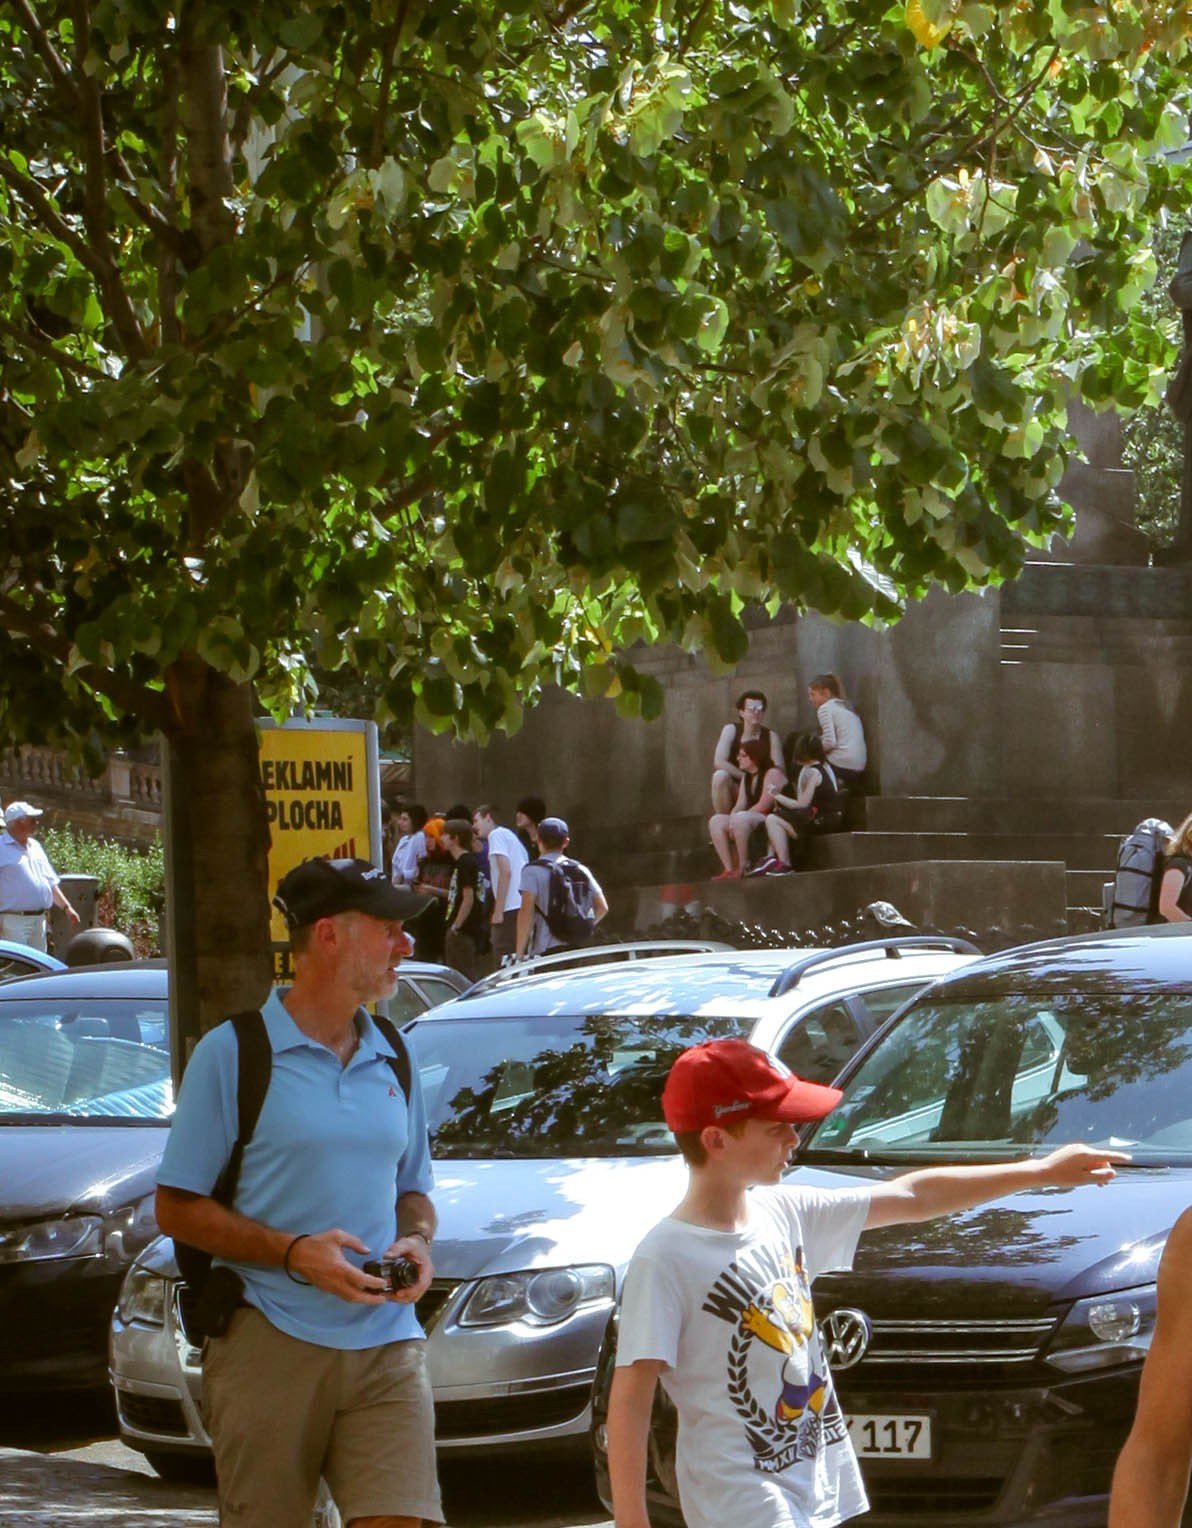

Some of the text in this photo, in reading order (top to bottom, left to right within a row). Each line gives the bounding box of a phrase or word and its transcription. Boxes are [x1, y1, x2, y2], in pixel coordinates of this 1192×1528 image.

[261, 755, 353, 792] EKLAMNÍ
[266, 800, 343, 831] PLOCHA
[862, 1420, 923, 1453] 117
